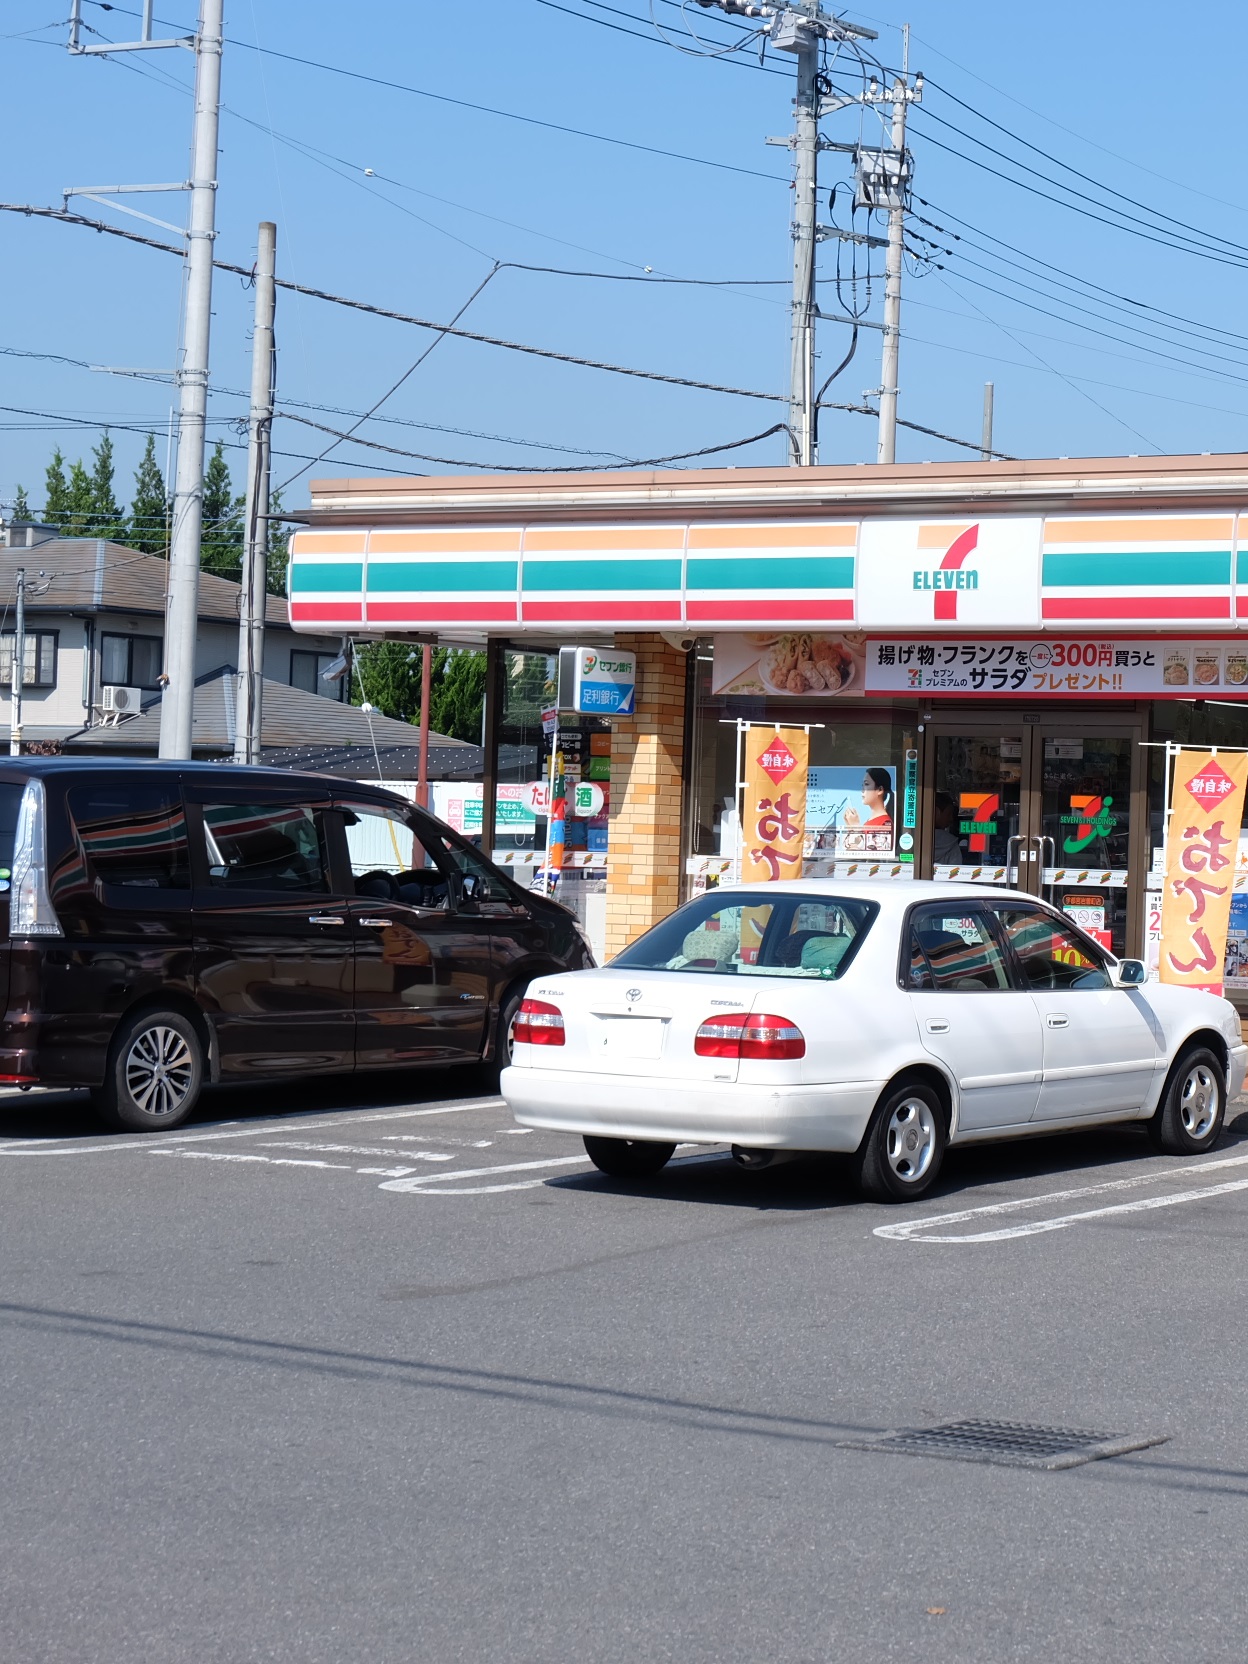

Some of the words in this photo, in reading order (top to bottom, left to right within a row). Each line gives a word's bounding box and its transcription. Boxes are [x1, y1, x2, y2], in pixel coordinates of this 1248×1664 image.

[600, 660, 633, 673] セブン銀行
[582, 688, 620, 706] 足利銀行
[575, 787, 592, 807] 酒
